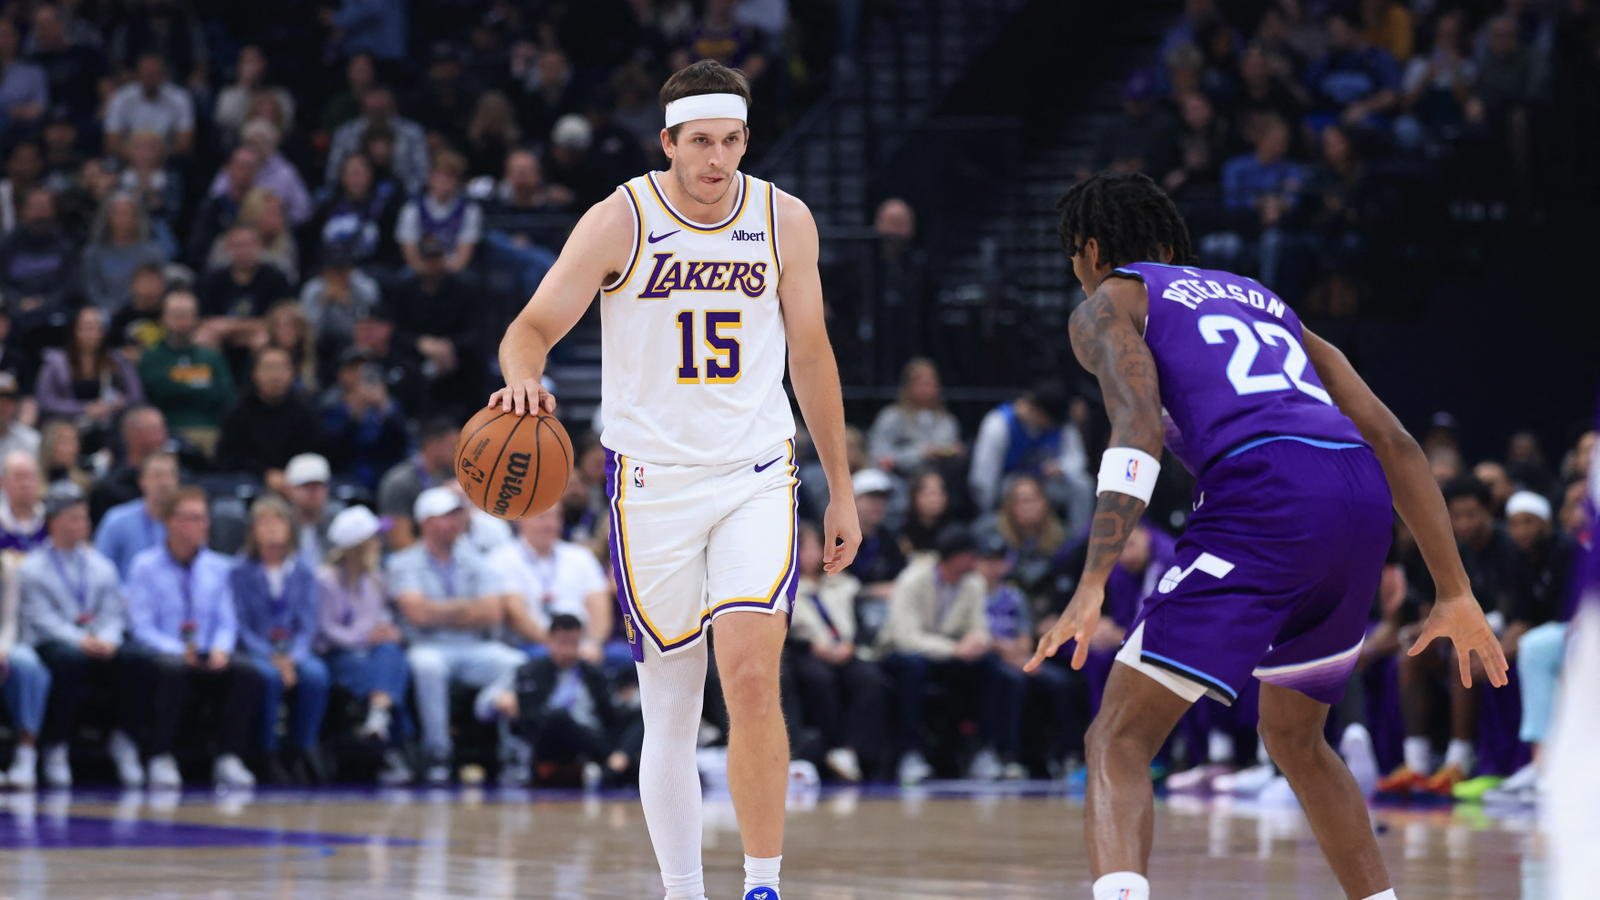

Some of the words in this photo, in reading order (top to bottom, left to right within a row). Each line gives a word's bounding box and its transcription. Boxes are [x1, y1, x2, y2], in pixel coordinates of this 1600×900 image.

[731, 230, 766, 241] Albert
[637, 251, 768, 299] LAKERS
[1162, 278, 1286, 319] PETERSON
[676, 309, 743, 384] 15
[1197, 314, 1334, 407] 22
[491, 452, 532, 516] Wilson
